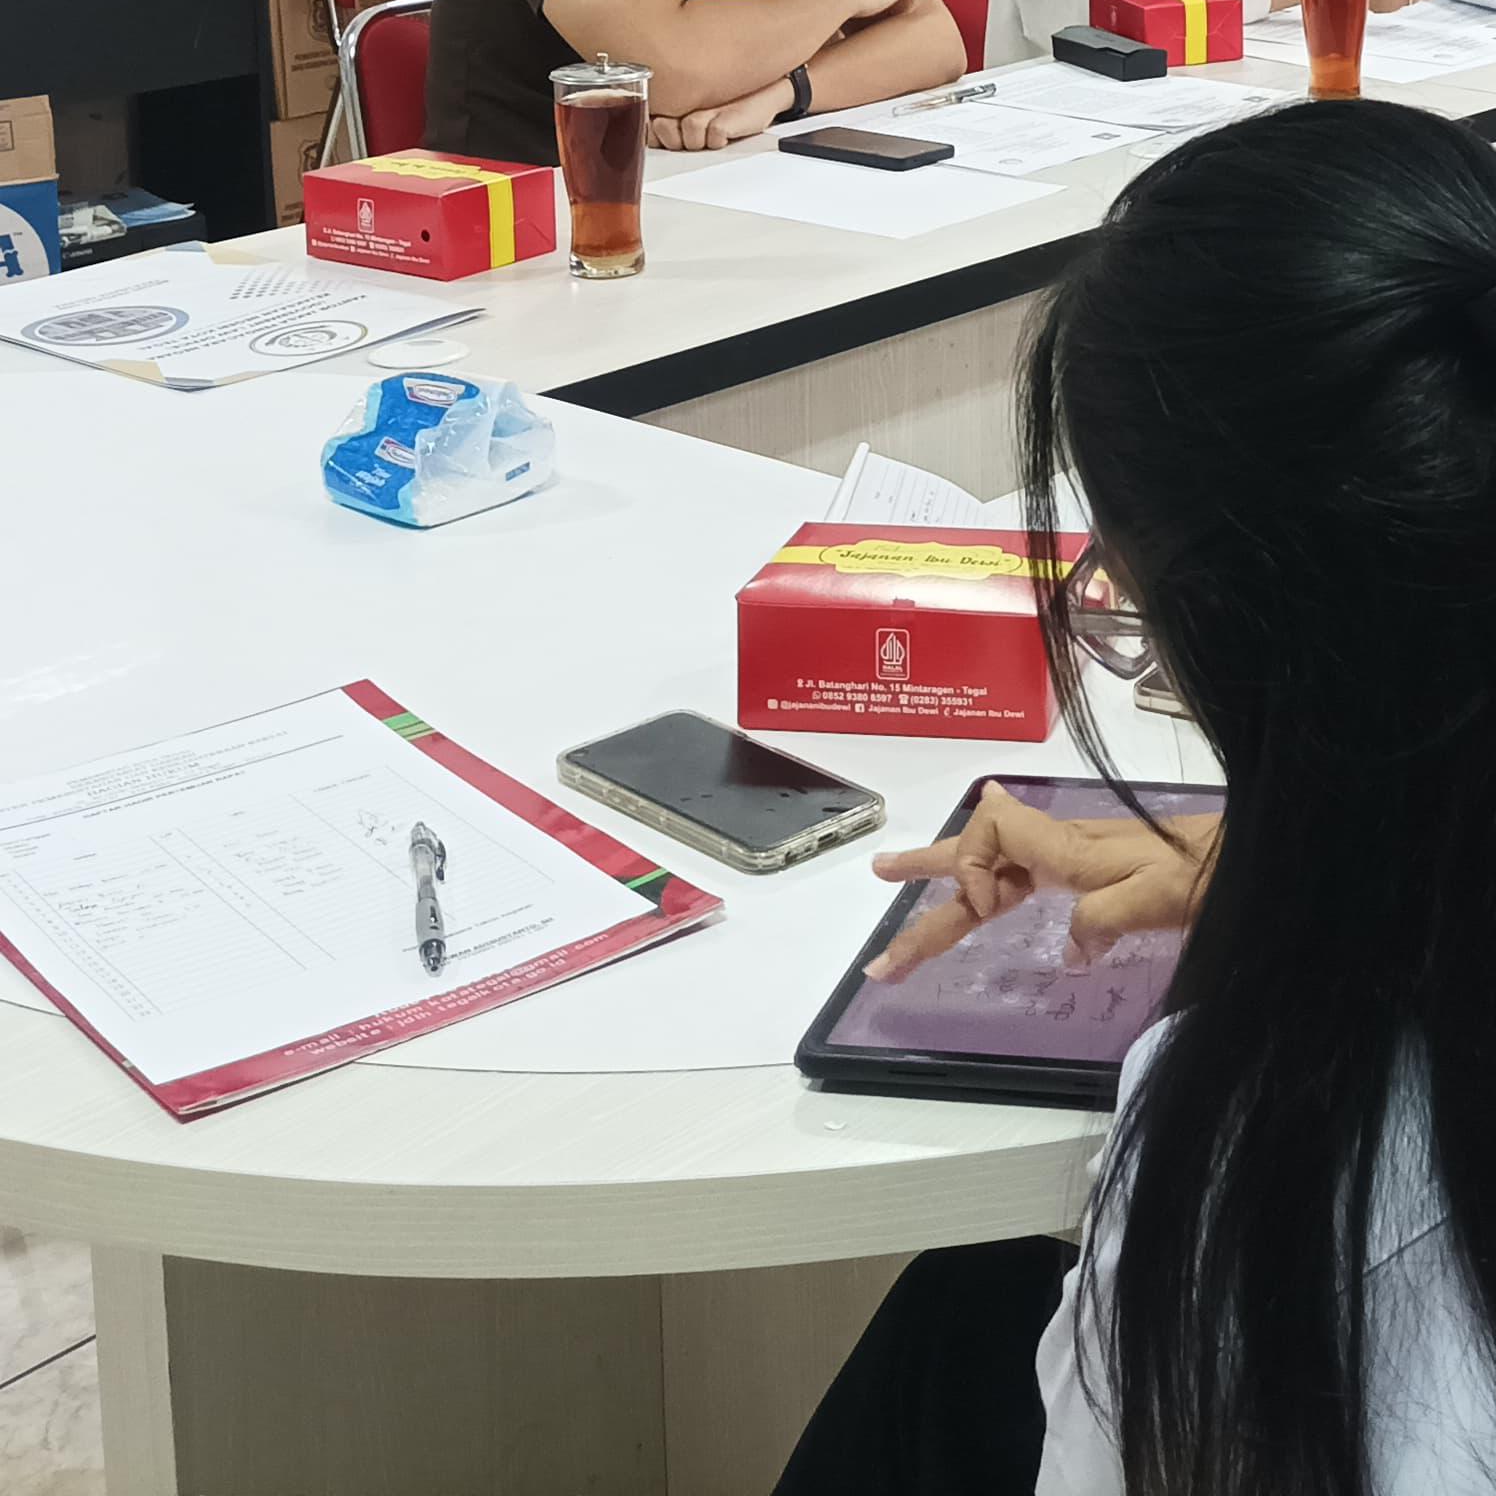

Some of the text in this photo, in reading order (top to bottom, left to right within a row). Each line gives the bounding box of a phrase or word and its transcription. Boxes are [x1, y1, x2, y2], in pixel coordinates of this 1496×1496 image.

[818, 681, 869, 692] Batanghari
[963, 686, 987, 697] Tegal
[284, 1033, 340, 1056] e-mail
[310, 1028, 381, 1055] website
